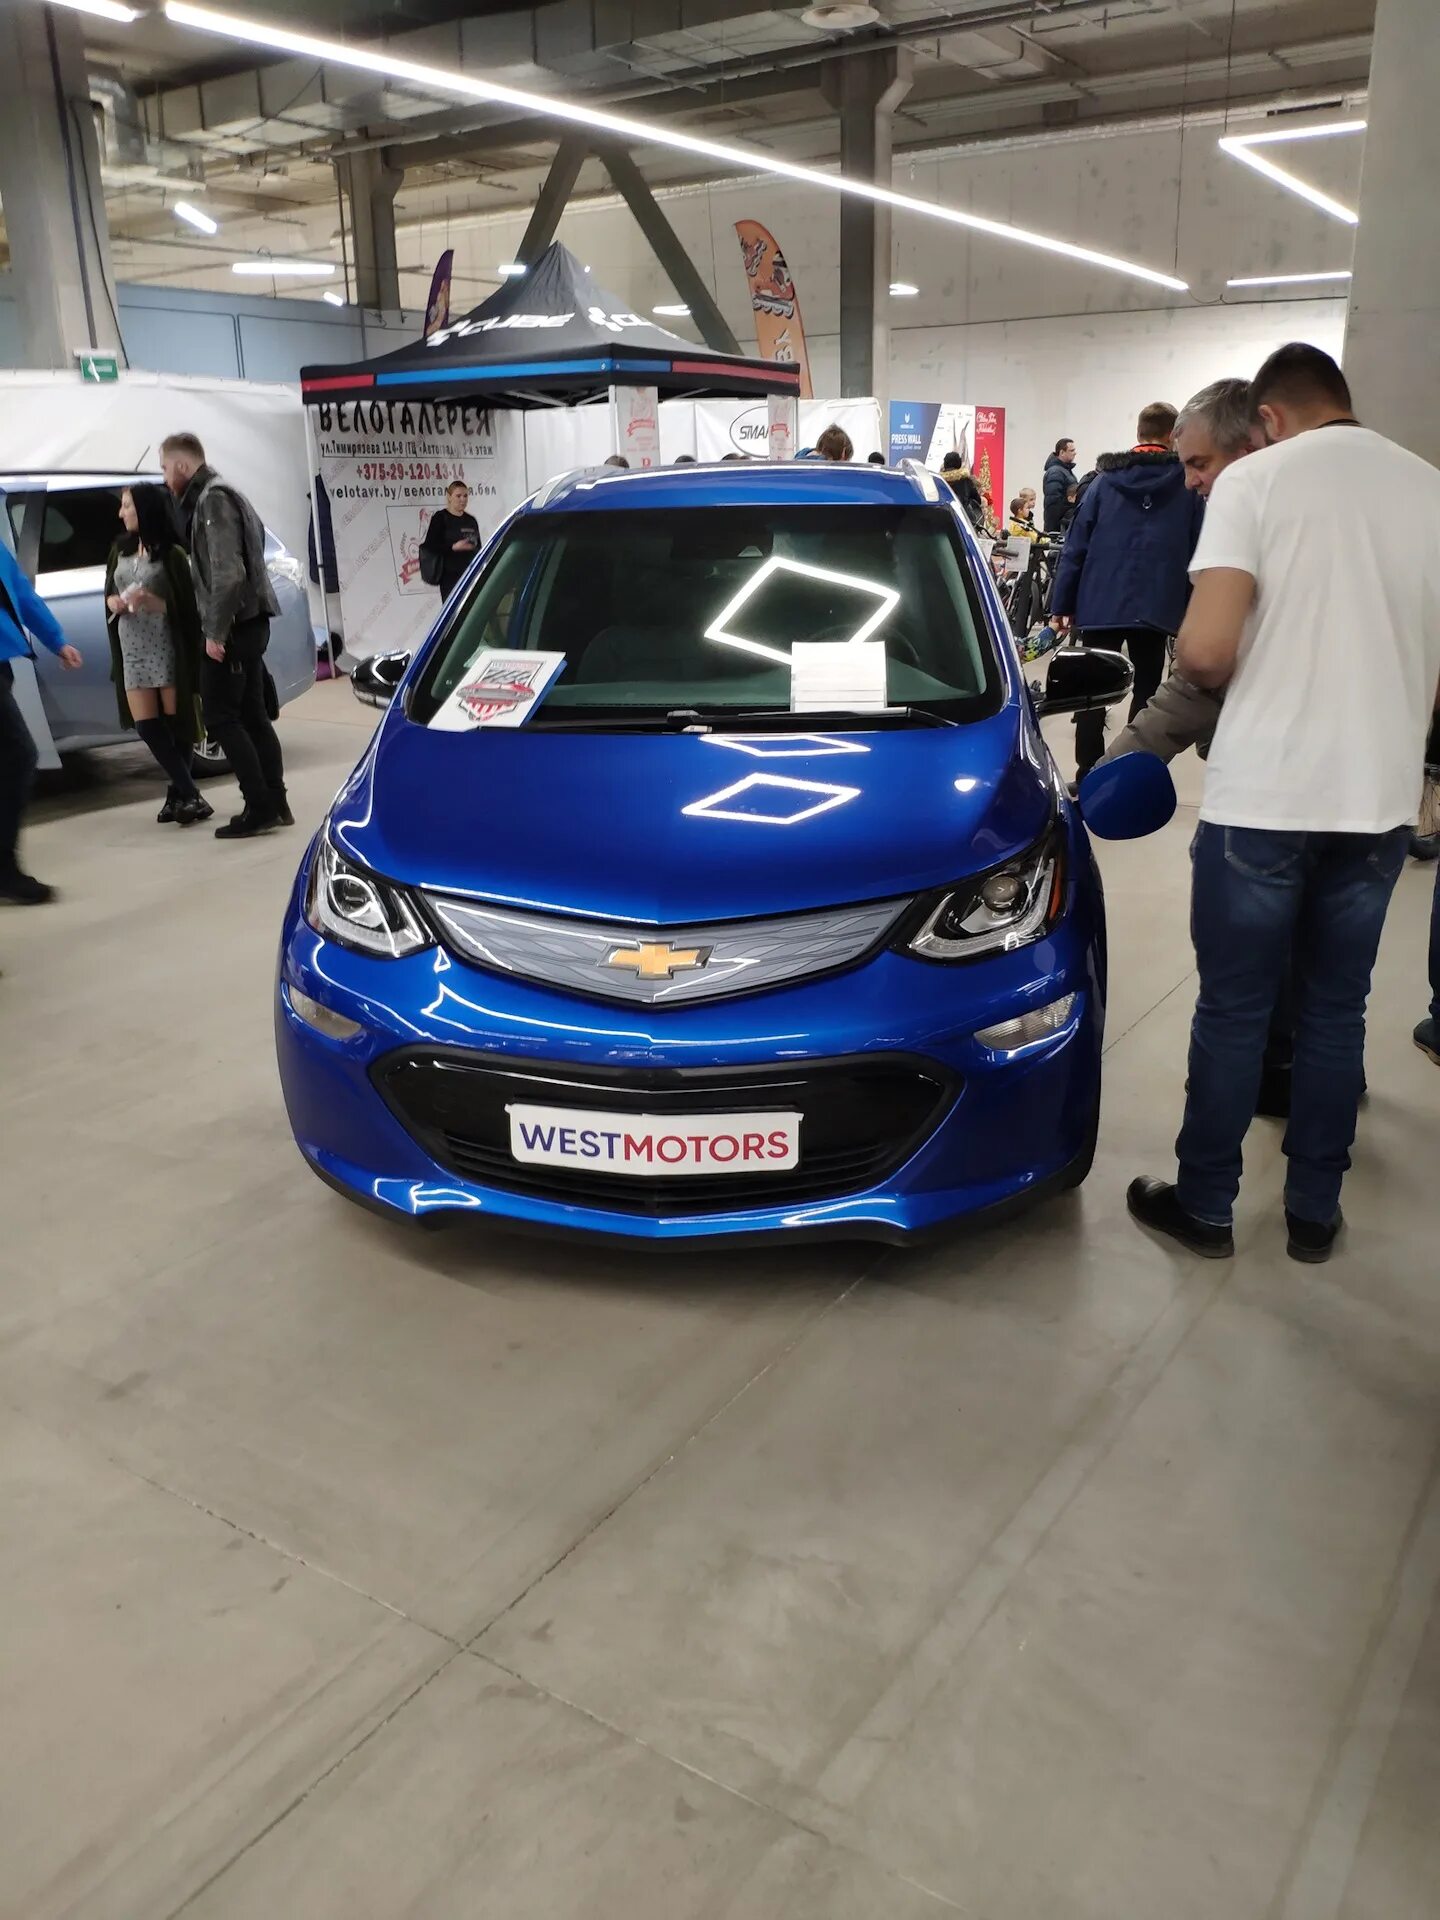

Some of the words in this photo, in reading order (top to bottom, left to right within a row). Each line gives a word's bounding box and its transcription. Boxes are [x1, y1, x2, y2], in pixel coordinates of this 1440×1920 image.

[458, 312, 576, 337] CUBE
[318, 401, 491, 436] ВЕЛОГАЛЕРЕЯ
[738, 424, 769, 440] SMA
[890, 432, 907, 444] PRESS
[907, 433, 922, 445] WALL
[518, 1122, 790, 1164] WESTMOTORS
